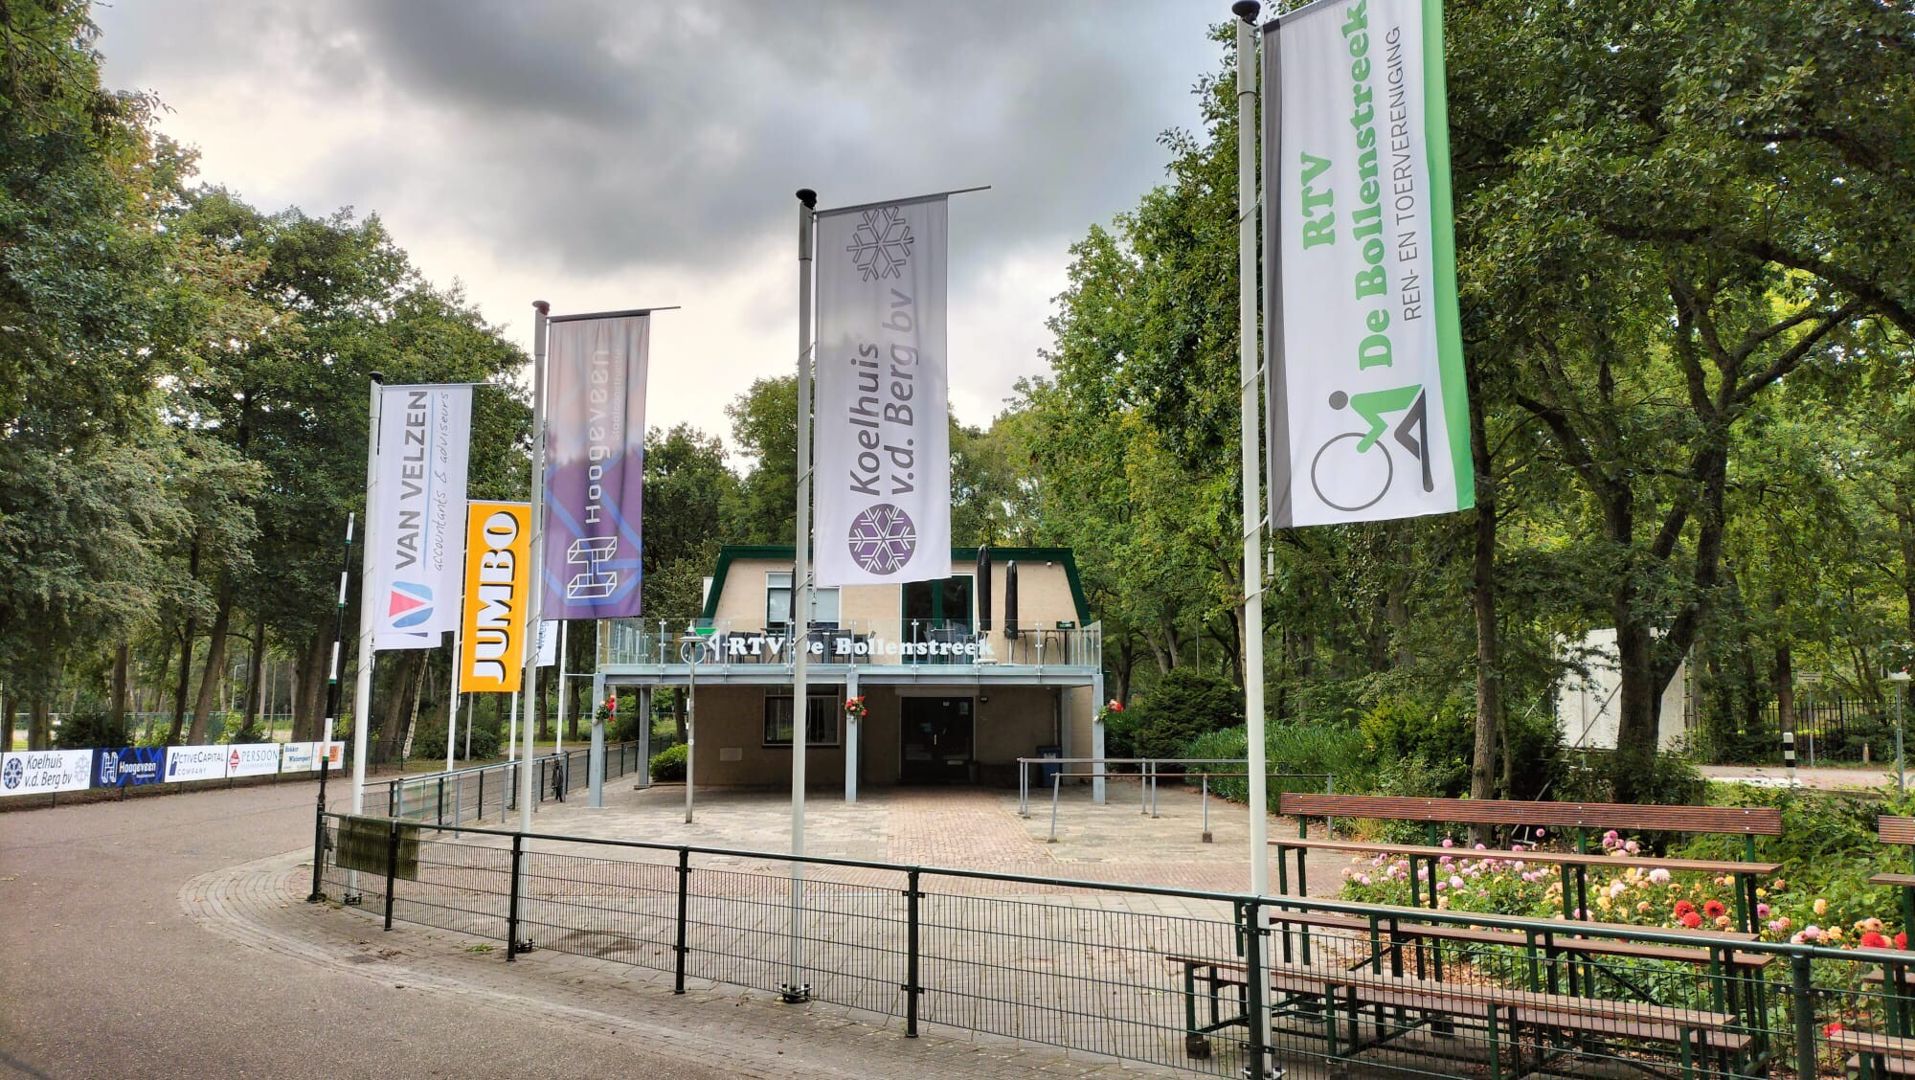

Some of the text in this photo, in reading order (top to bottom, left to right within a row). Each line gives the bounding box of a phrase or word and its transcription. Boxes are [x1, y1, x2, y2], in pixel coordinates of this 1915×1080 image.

[1300, 151, 1335, 251] RTV
[1340, 0, 1393, 371] De Bollenstreek
[1384, 25, 1422, 323] REN- EN TOERVERENIGING
[439, 392, 449, 465] adviseurs
[585, 350, 611, 524] Hoogeveen
[849, 342, 880, 497] Koelhuis
[882, 287, 919, 495] v.d. Berg bv
[395, 391, 428, 570] VAN VELZEN
[435, 491, 448, 571] accountants
[473, 511, 520, 685] JUMBO
[729, 637, 785, 655] RTV
[835, 637, 994, 656] Bollenstreek
[24, 770, 73, 789] v.d. Berg bv
[26, 754, 63, 771] Koelhuis
[119, 760, 157, 774] Hoogeveen
[241, 749, 278, 762] PERSOON
